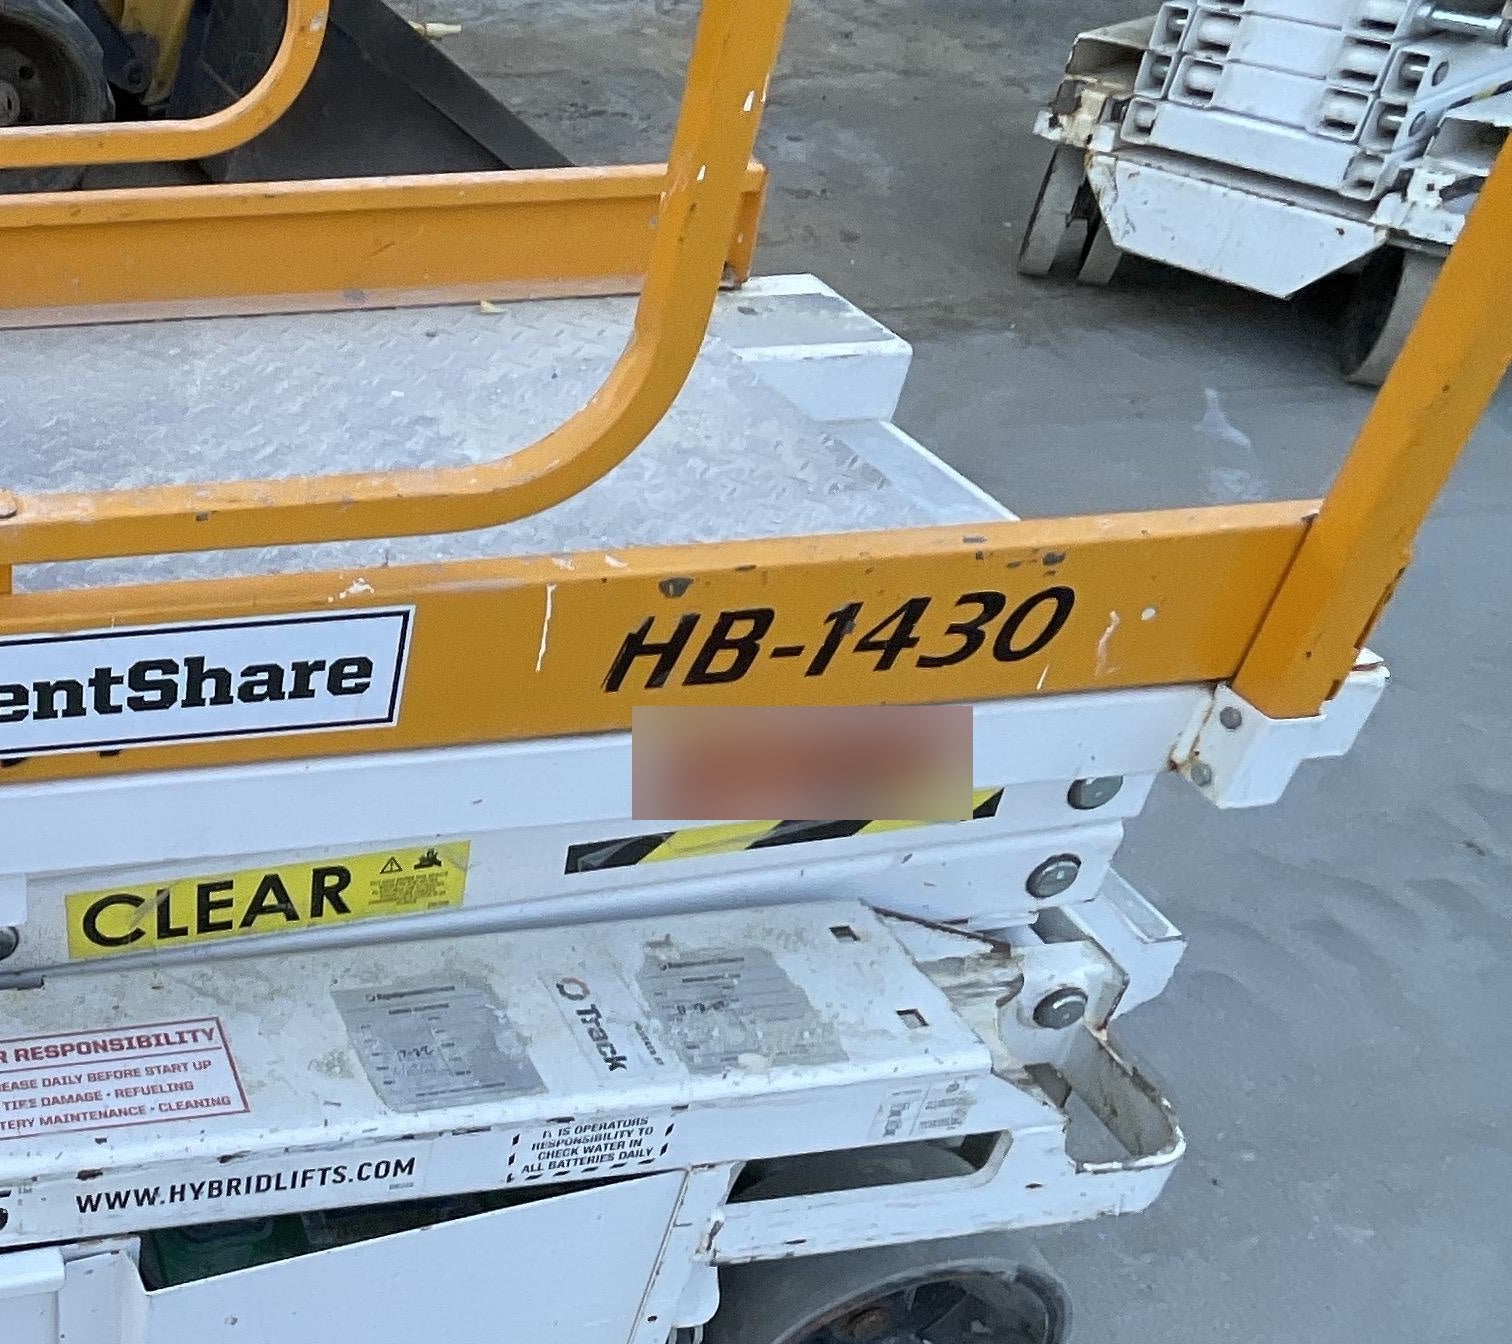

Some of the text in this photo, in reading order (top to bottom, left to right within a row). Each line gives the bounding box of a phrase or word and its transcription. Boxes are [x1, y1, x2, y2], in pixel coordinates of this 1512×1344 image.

[602, 586, 1076, 693] HB-1430
[82, 865, 352, 947] CLEAR
[15, 1028, 214, 1062] RESPONSIBILITY
[576, 1003, 628, 1072] Track
[42, 1074, 82, 1088] DAILY
[88, 1069, 141, 1082] BEFORE
[145, 1062, 188, 1076] START
[192, 1060, 212, 1071] UP
[3, 1099, 38, 1112] TIRE
[41, 1090, 103, 1106] DAMAGE
[114, 1081, 194, 1098] REFUELING
[39, 1106, 146, 1126] MAINTENANCE
[158, 1096, 231, 1112] CLEANING
[531, 1126, 654, 1151] RESPONSIBILITY TO
[558, 1127, 571, 1136] IS
[574, 1117, 649, 1135] OPERATORS
[521, 1147, 654, 1174] ALL BATTERIES DAILY
[537, 1138, 643, 1161] CHECK WATER IN
[76, 1156, 416, 1214] WWW.HYBRIDLIFTS.COM
